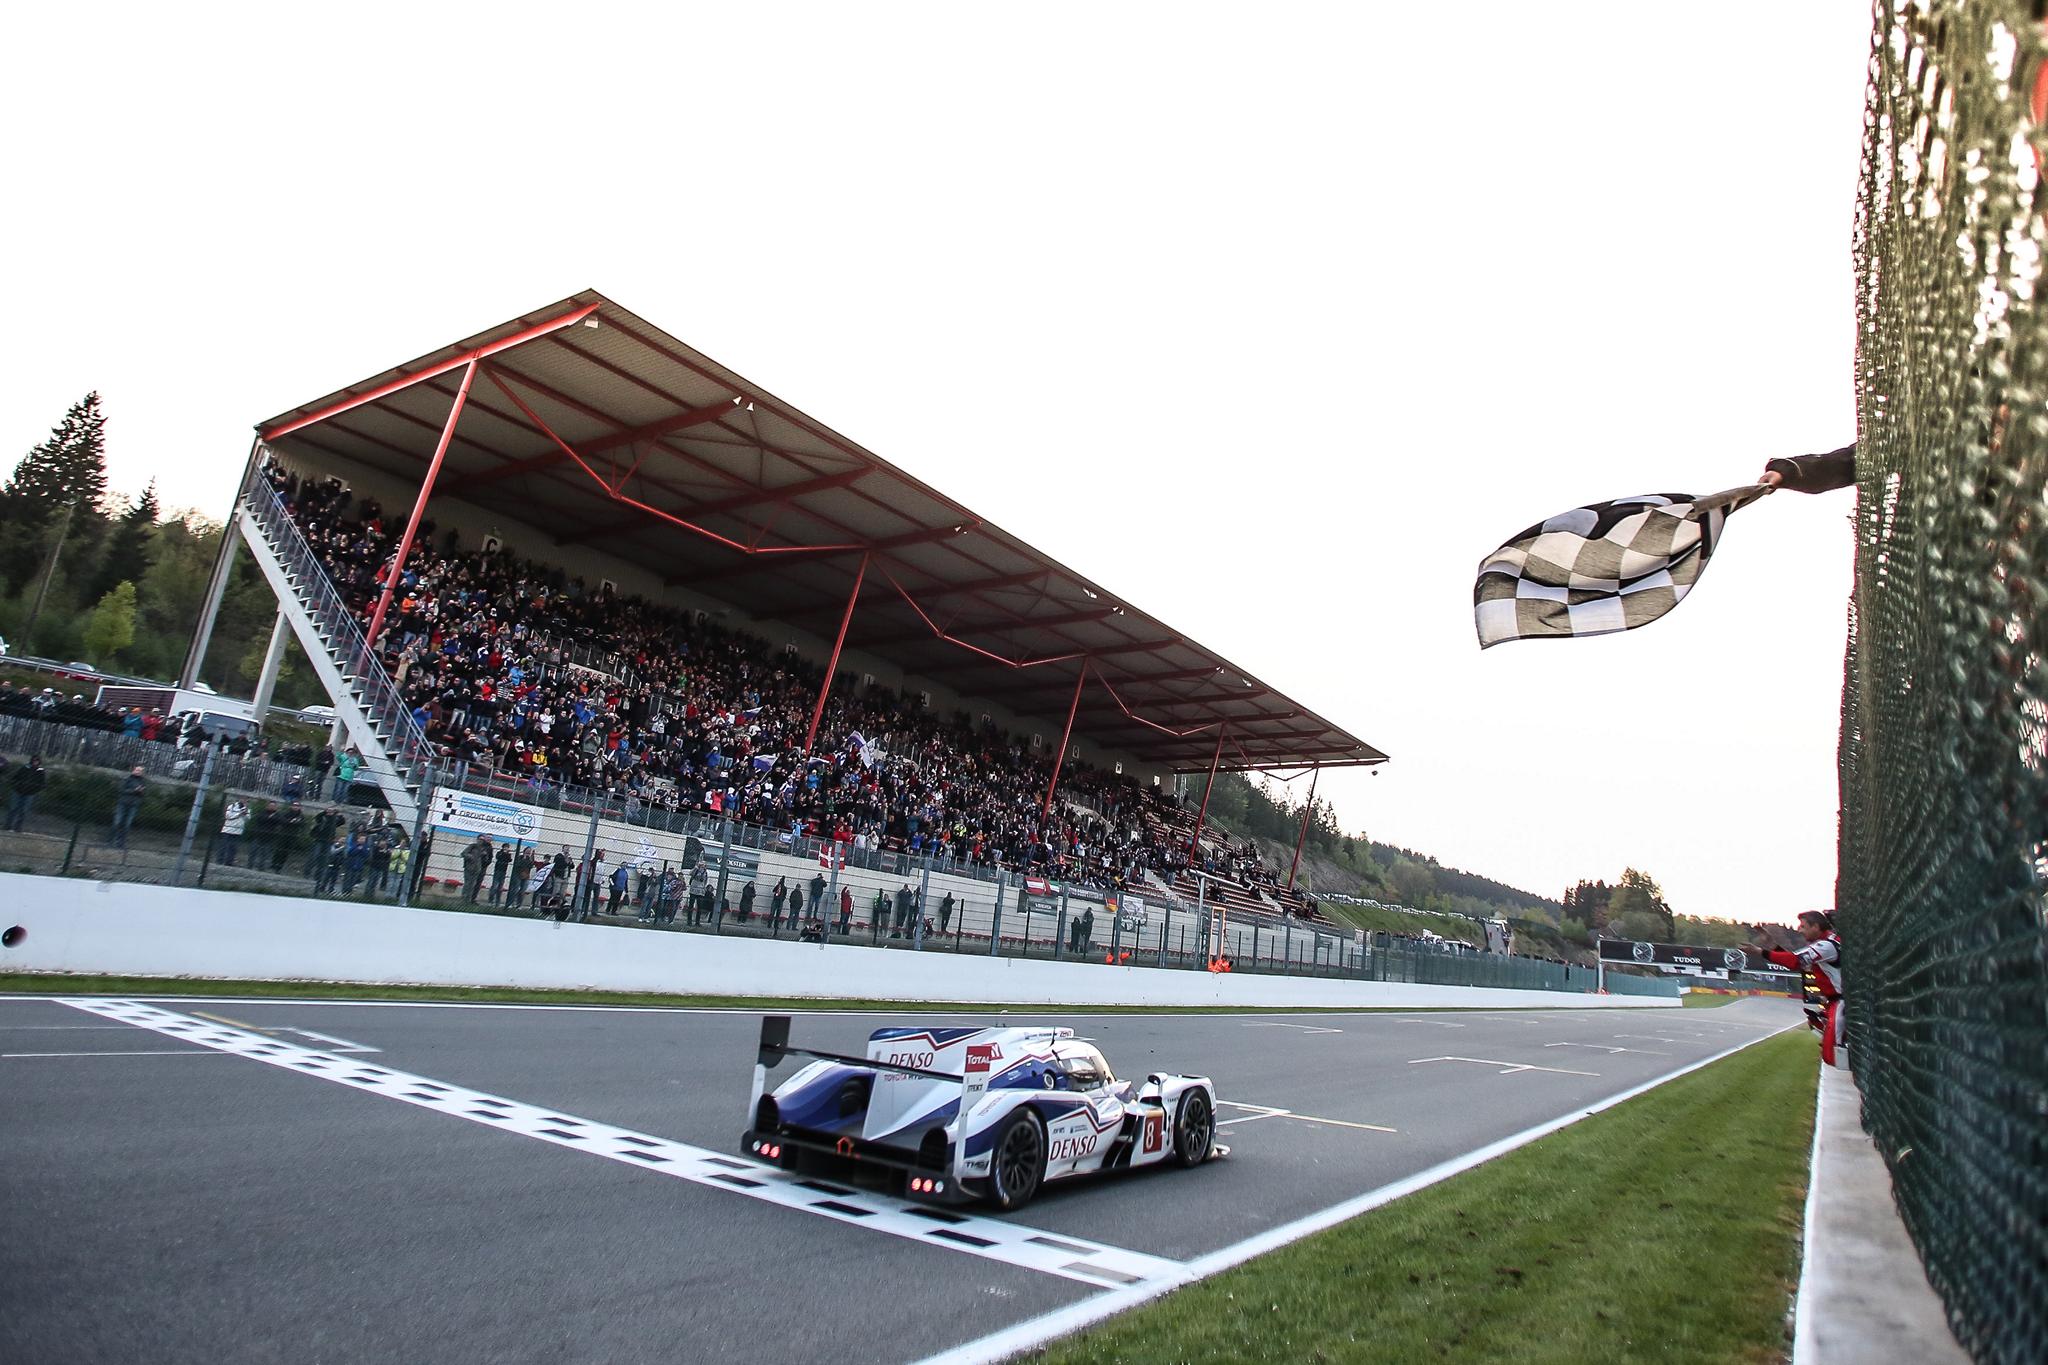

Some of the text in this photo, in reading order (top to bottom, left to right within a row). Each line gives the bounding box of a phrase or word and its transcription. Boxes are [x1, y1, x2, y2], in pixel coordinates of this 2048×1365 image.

[1673, 955, 1701, 964] TUDOR
[889, 1052, 934, 1068] DENSO
[967, 1054, 991, 1065] TOTAL
[1145, 1120, 1155, 1150] 8
[1049, 1134, 1098, 1161] DENSO
